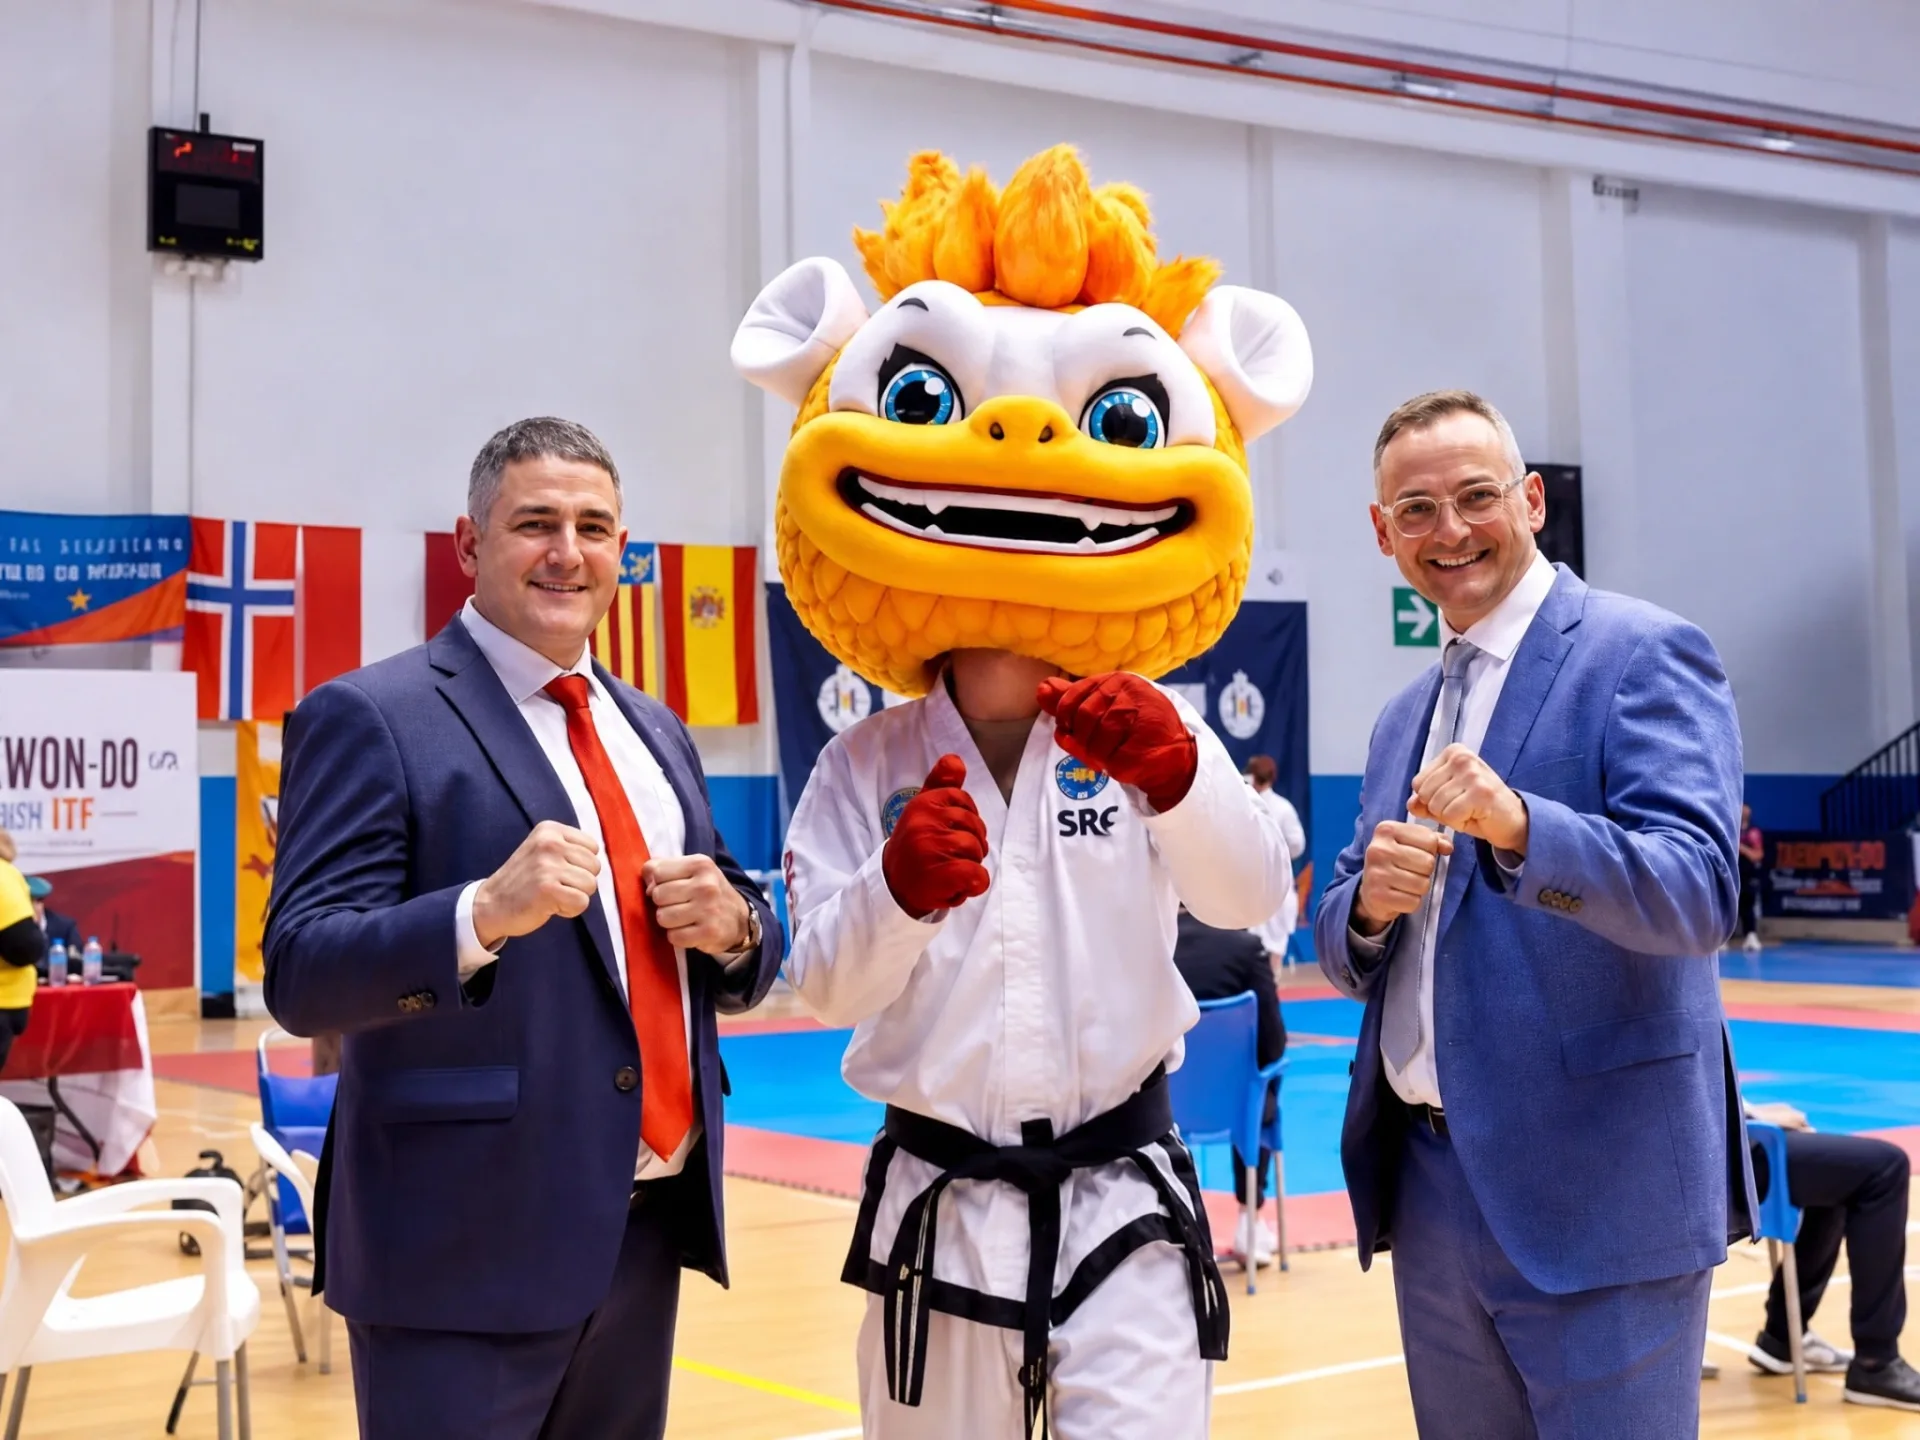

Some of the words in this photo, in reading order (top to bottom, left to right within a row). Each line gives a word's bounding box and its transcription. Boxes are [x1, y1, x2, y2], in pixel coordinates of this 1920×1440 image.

[0, 737, 138, 790] WON-DO
[52, 796, 95, 831] ITF
[1057, 806, 1119, 837] SRC
